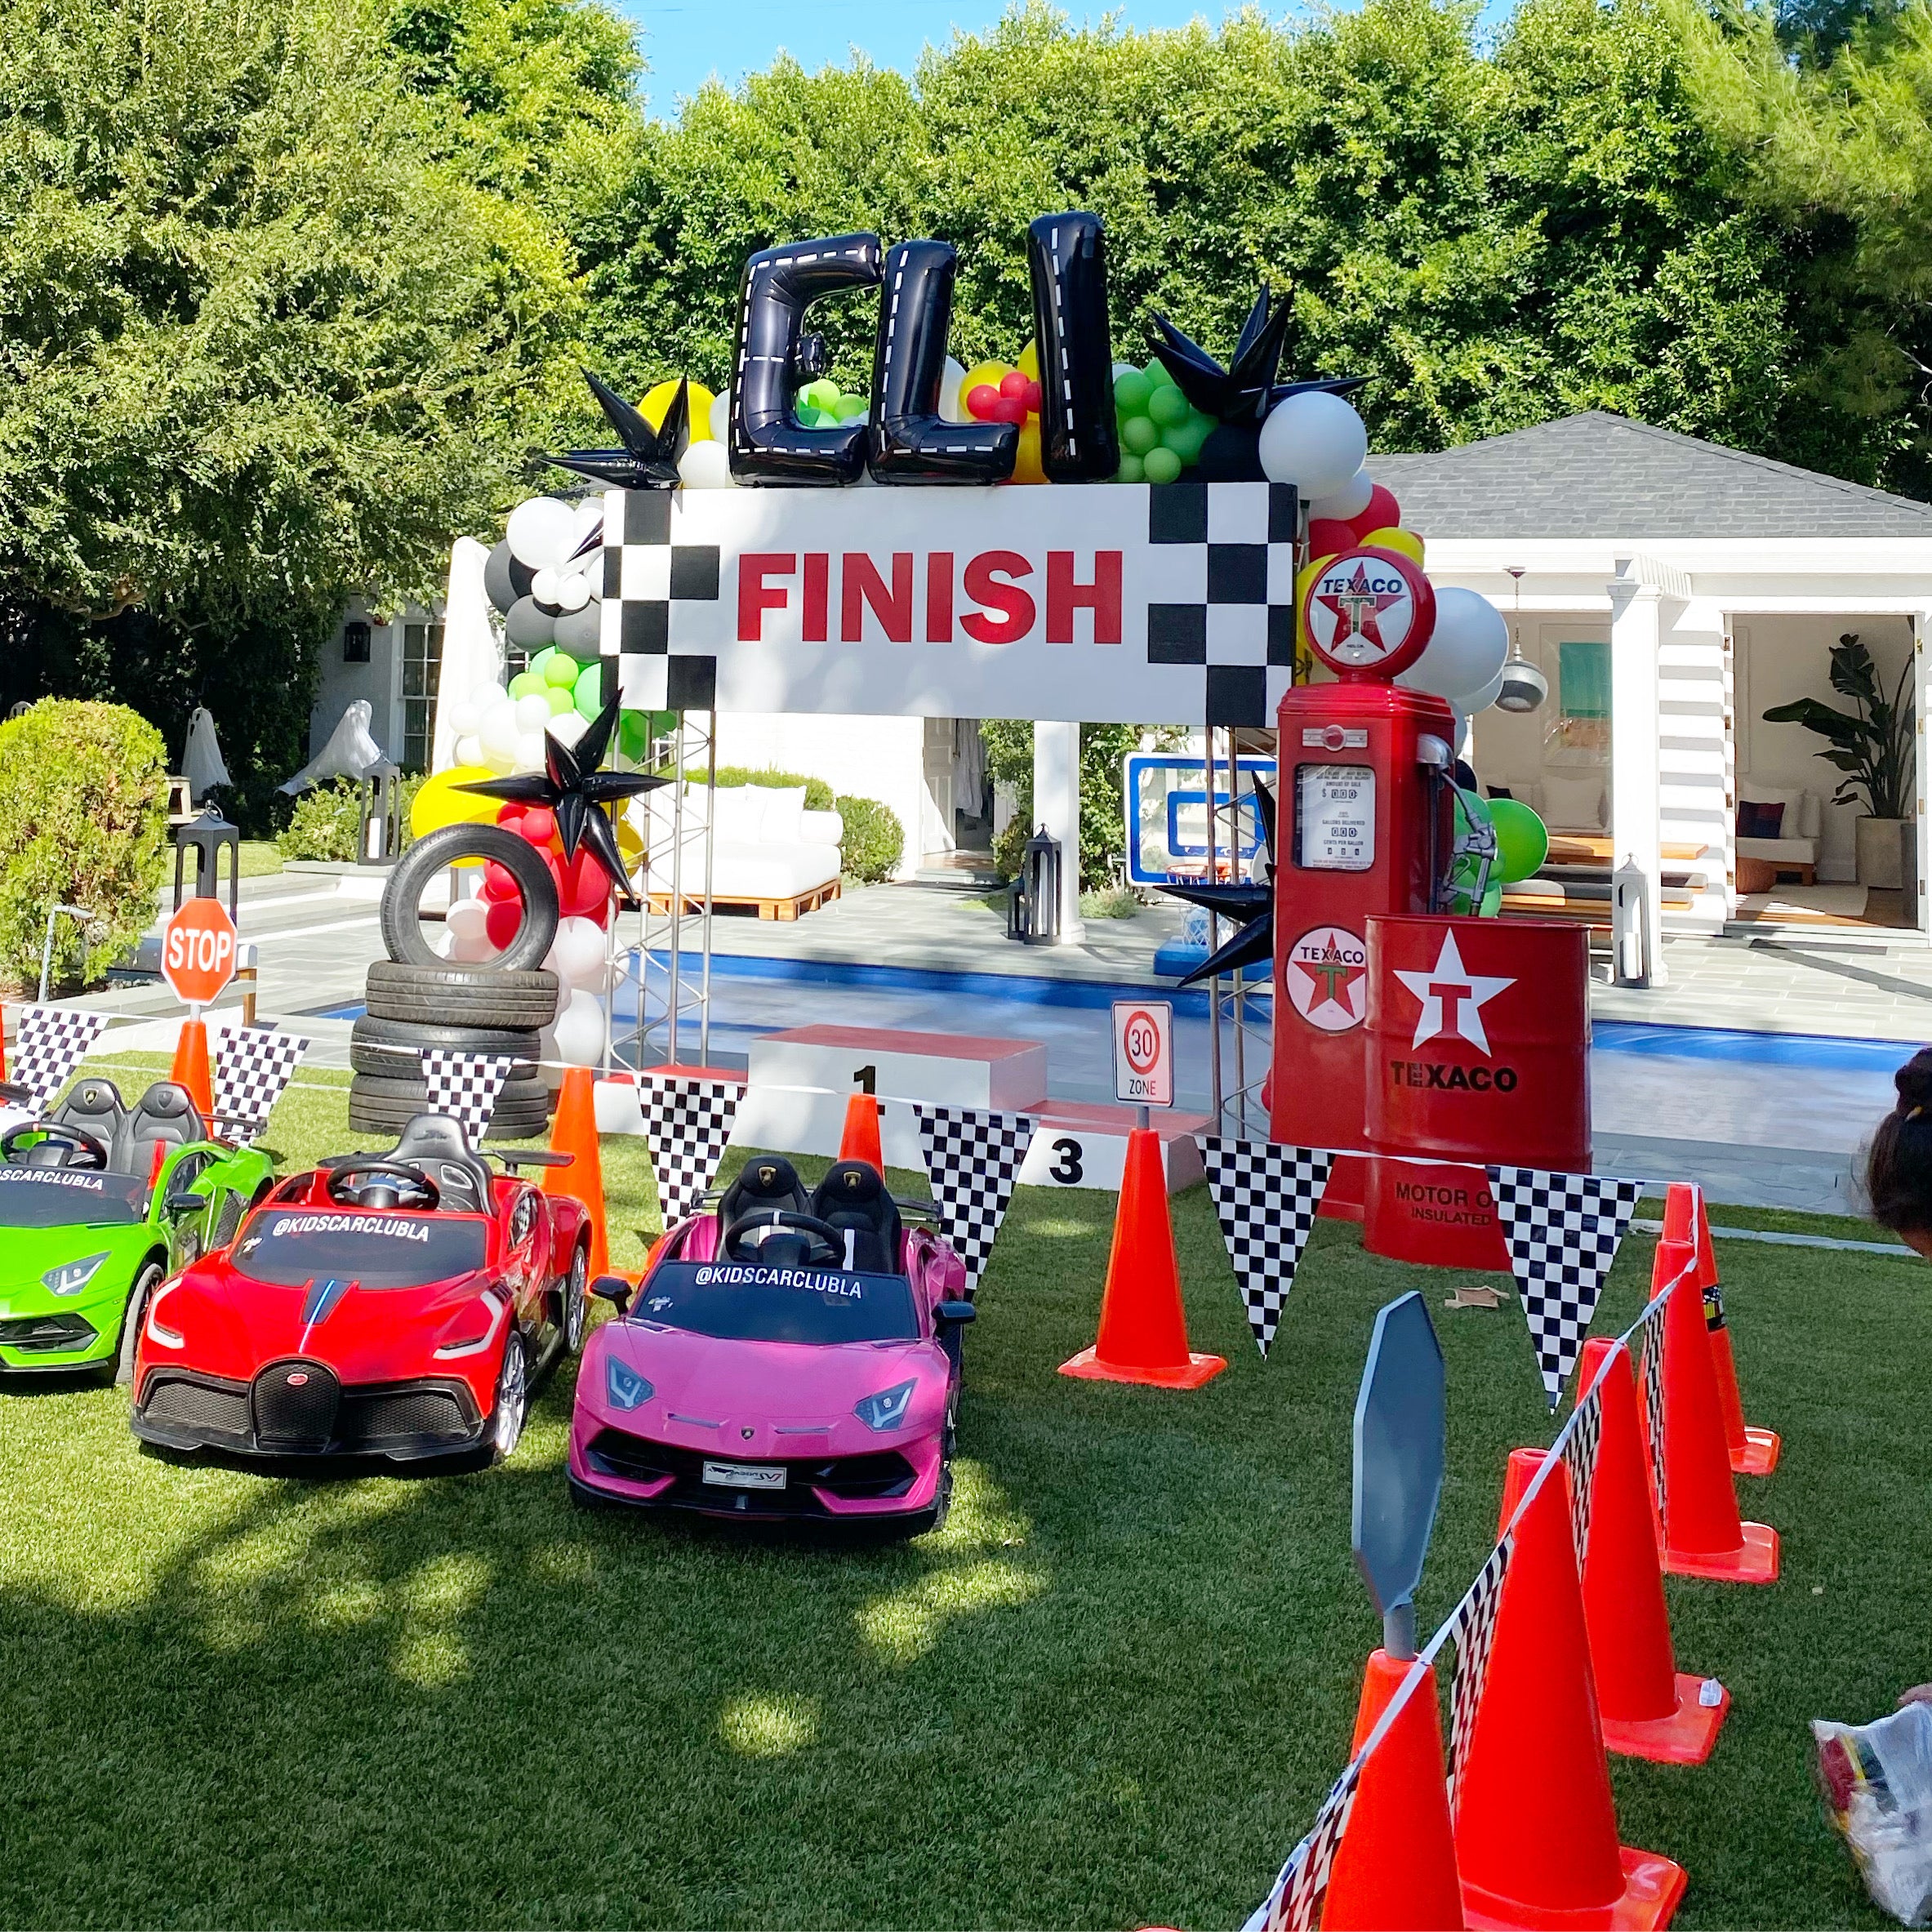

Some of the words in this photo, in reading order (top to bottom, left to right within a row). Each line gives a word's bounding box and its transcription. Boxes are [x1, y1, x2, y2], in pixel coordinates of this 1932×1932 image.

[729, 210, 1121, 487] ELI
[737, 550, 1124, 644] FINISH
[1324, 578, 1403, 594] TEXACO
[1338, 595, 1378, 634] T
[168, 927, 231, 973] STOP
[1300, 946, 1364, 964] TEXACO
[1315, 964, 1348, 999] T
[1429, 982, 1472, 1037] T
[1132, 1029, 1153, 1057] 30
[853, 1066, 885, 1115] 1
[1129, 1079, 1156, 1096] ZONE
[1390, 1060, 1518, 1093] TEXACO
[1049, 1137, 1084, 1185] 3
[0, 1169, 104, 1191] SCARCLUBLA
[1396, 1181, 1469, 1207] MOTOR
[1476, 1191, 1494, 1209] O
[272, 1215, 430, 1242] @KIDSCARCLUBLA
[1411, 1206, 1492, 1226] INSULATED
[695, 1266, 862, 1299] @KIDSCARCLUBLA
